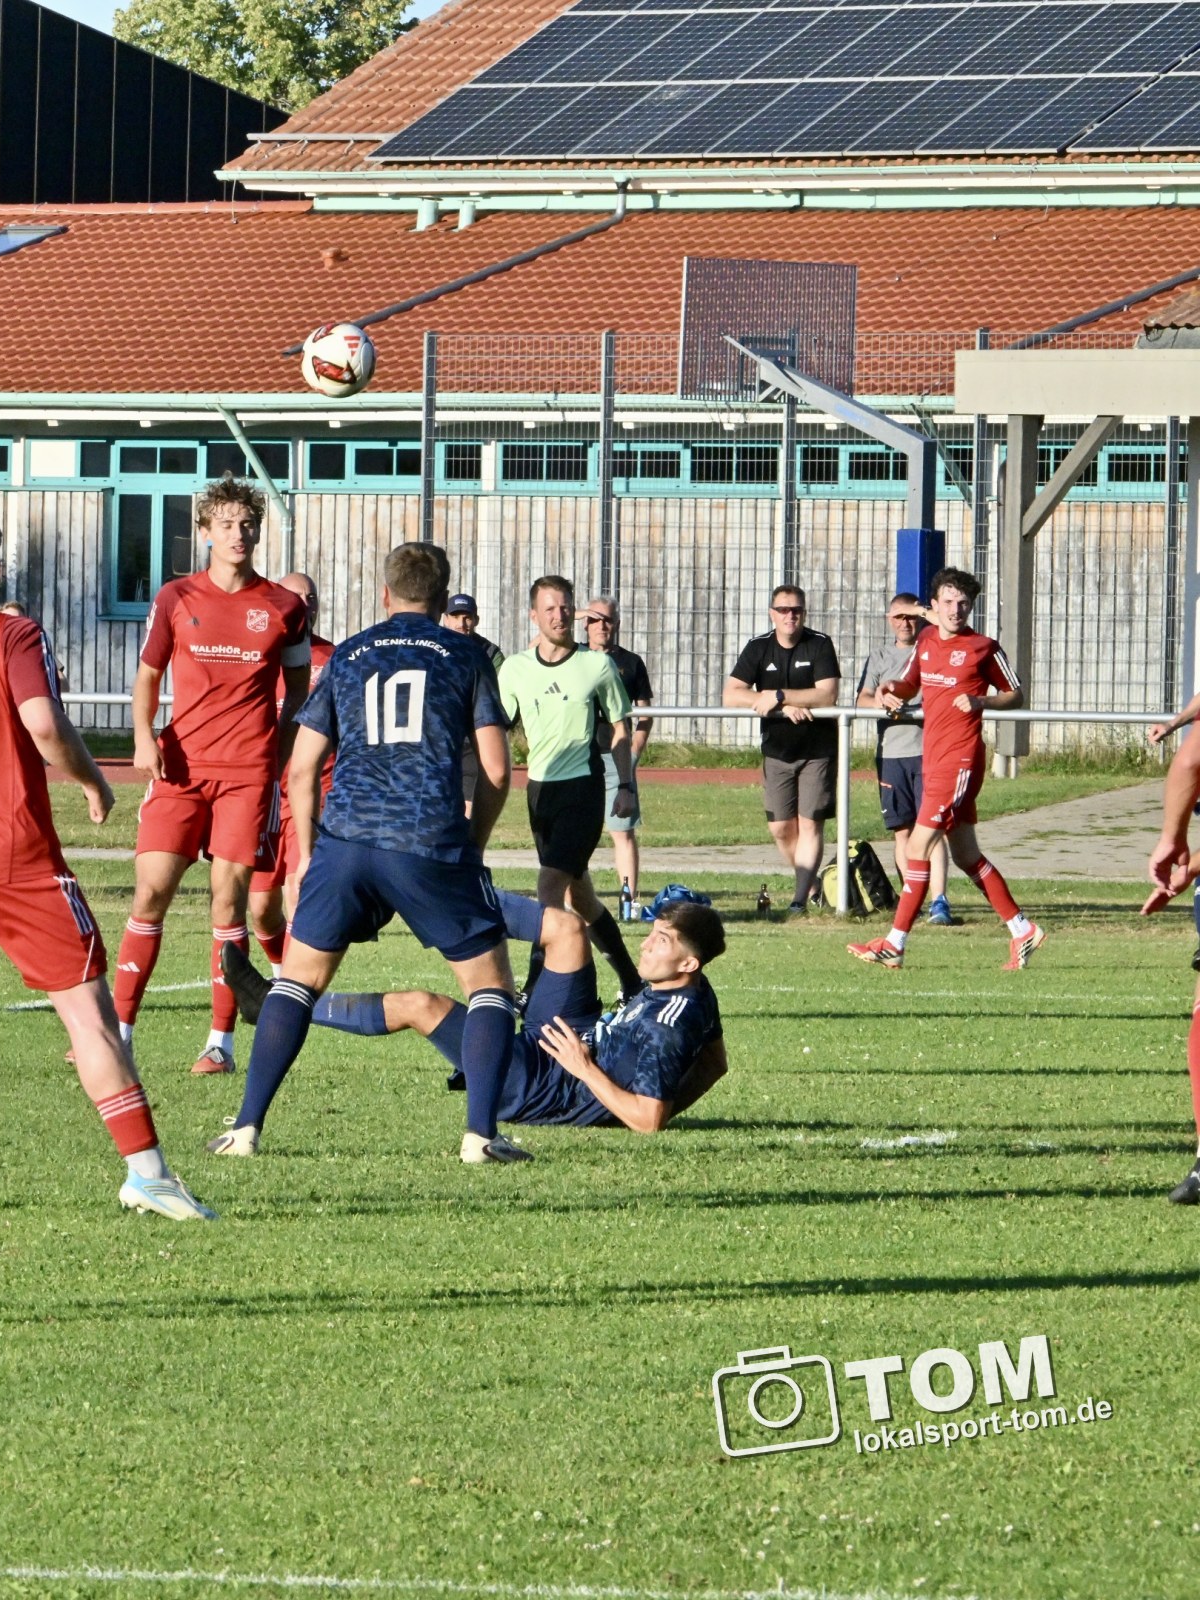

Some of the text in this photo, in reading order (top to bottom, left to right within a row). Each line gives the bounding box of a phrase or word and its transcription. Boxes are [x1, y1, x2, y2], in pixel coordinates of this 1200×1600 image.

[190, 645, 241, 655] WALDHÖR
[374, 638, 450, 658] DENKLINGEN
[365, 669, 427, 745] 10
